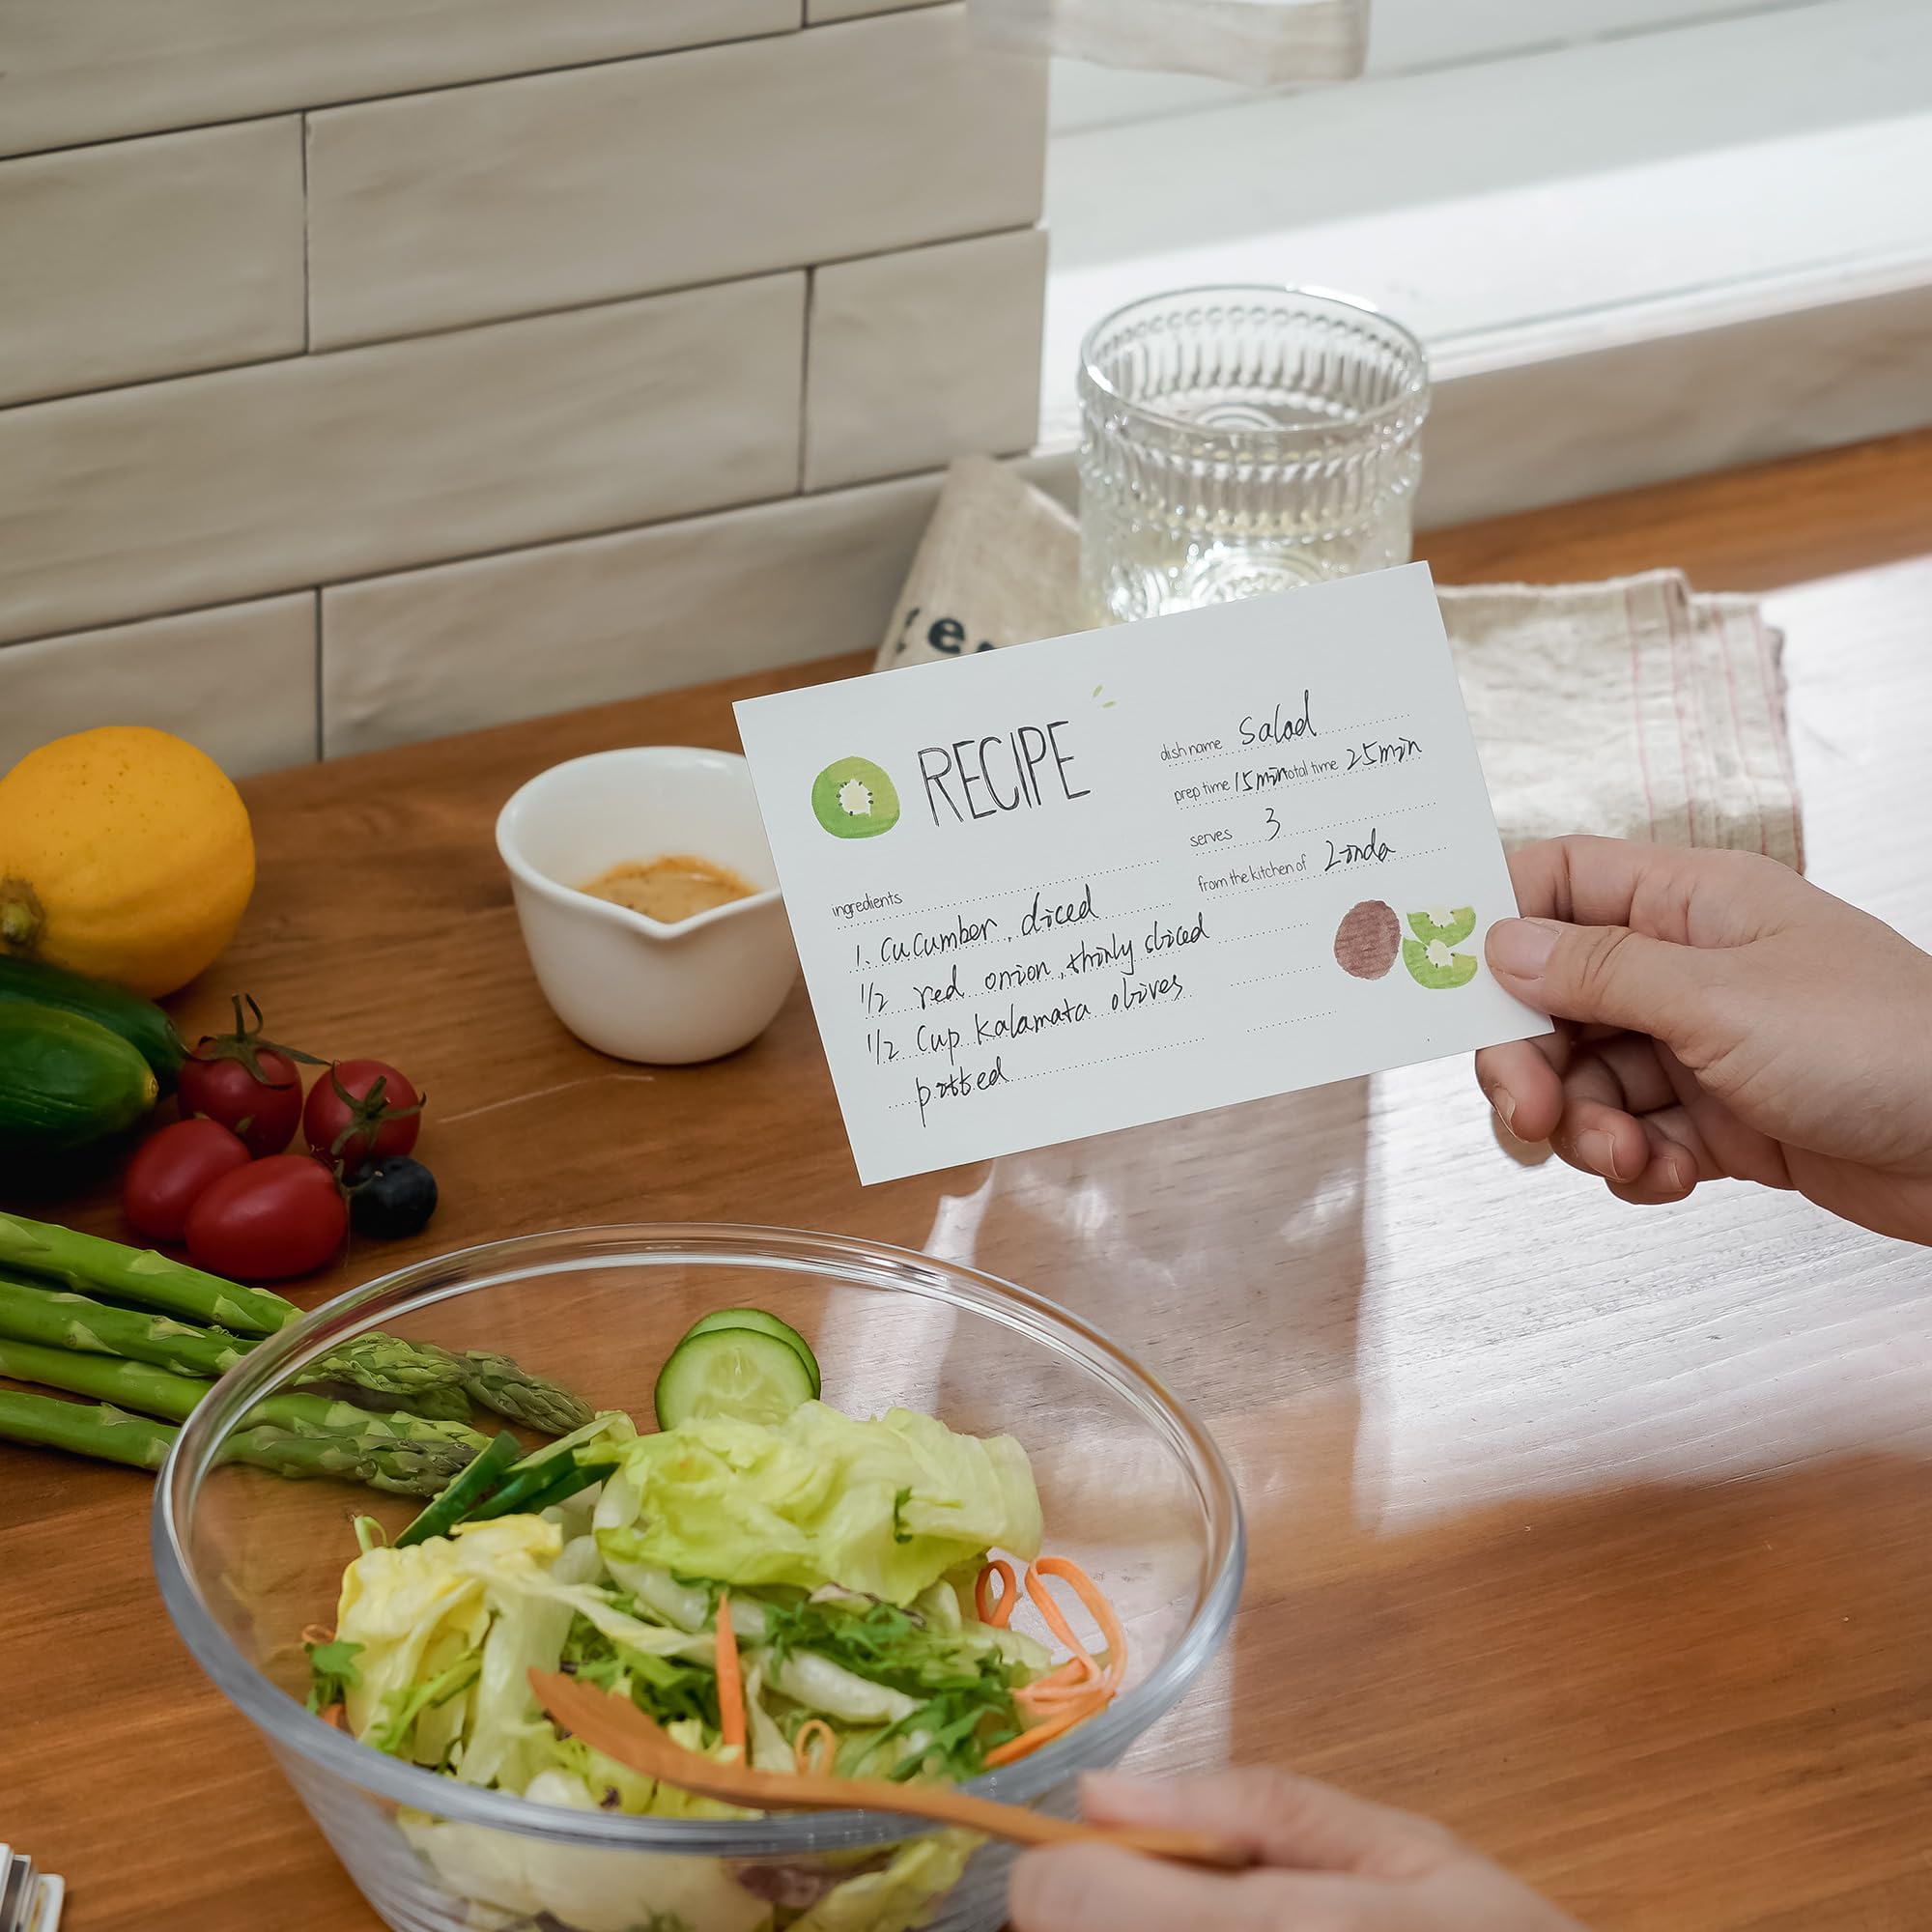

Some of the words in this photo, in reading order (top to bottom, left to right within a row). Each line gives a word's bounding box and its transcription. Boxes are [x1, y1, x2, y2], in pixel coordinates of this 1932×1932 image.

[1160, 743, 1188, 761] dish
[1188, 738, 1223, 754] name
[917, 721, 1092, 827] RECIPE
[1310, 759, 1339, 775] time
[1174, 786, 1201, 804] prep
[1202, 780, 1231, 795] time
[1189, 828, 1234, 847] serves
[1264, 808, 1281, 841] 3
[1197, 874, 1229, 893] from
[1229, 867, 1250, 886] the
[1248, 860, 1295, 881] kitchen
[1294, 853, 1307, 872] of
[831, 892, 904, 920] ingredients
[1020, 883, 1100, 937] diced
[912, 964, 965, 1010] red
